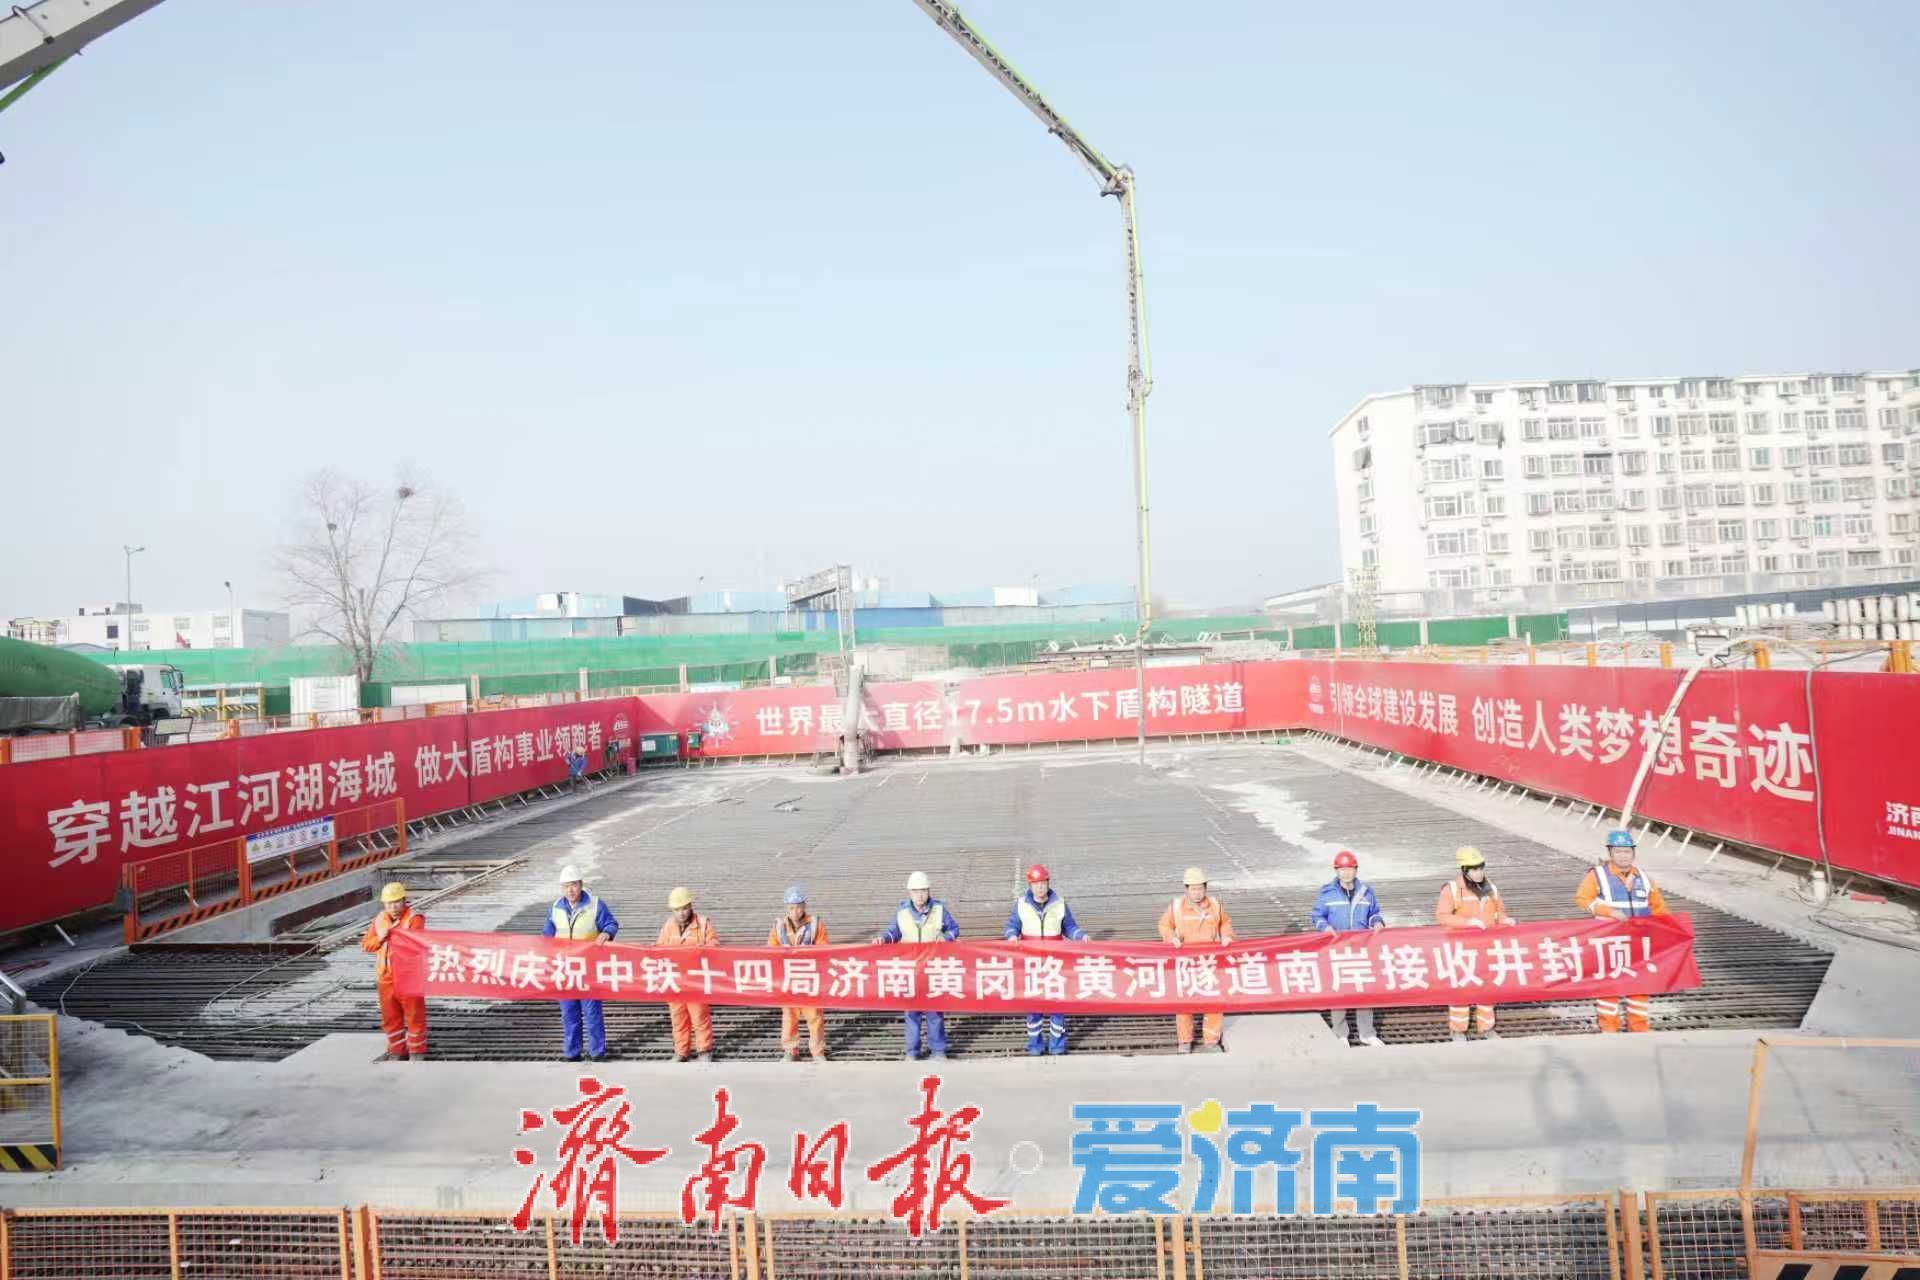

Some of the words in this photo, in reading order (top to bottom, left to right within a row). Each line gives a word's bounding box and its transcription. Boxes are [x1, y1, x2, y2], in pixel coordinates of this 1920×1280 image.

[47, 751, 397, 868] 穿越江河湖海城
[414, 720, 603, 789] 做大盾构事业领跑者
[1329, 682, 1459, 737] 引领全球建设发展
[1471, 696, 1814, 802] 创造人类梦想奇迹
